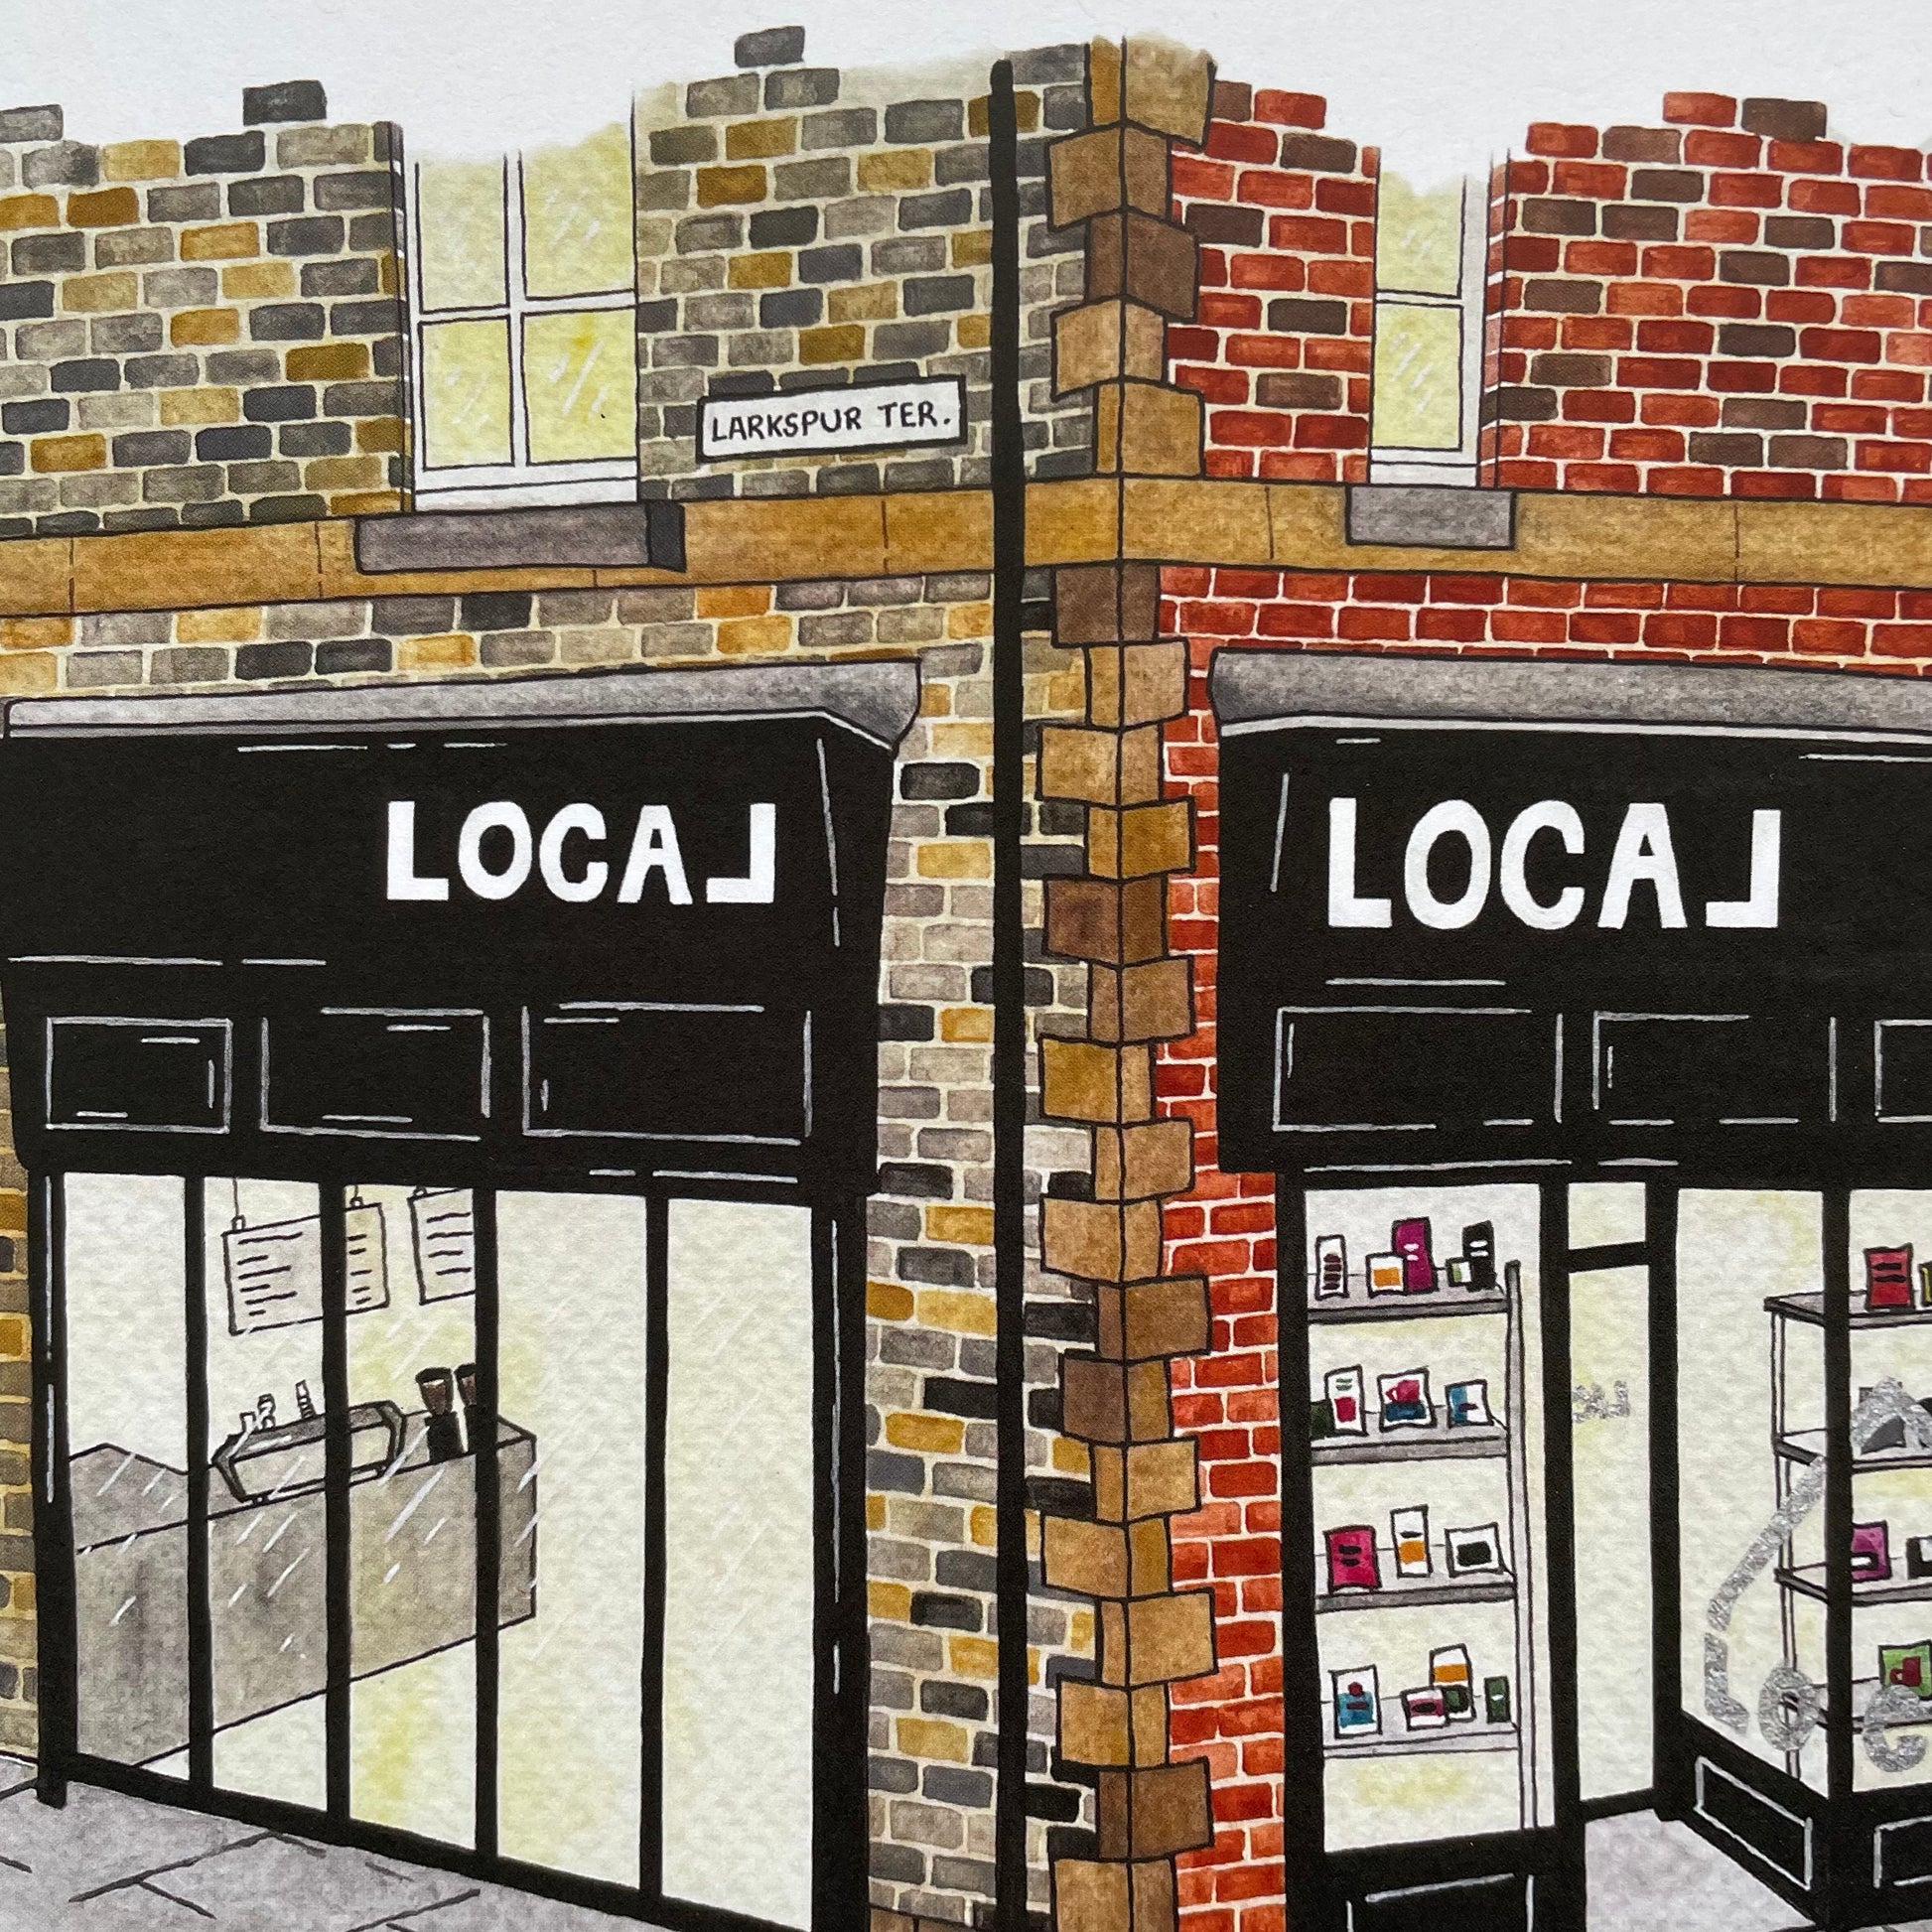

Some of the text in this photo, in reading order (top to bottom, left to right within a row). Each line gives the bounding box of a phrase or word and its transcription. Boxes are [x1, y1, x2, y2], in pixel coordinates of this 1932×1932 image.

[711, 400, 952, 443] LARKSPUR TER.
[386, 800, 776, 905] LOCAL
[1327, 796, 1782, 930] LOCAL
